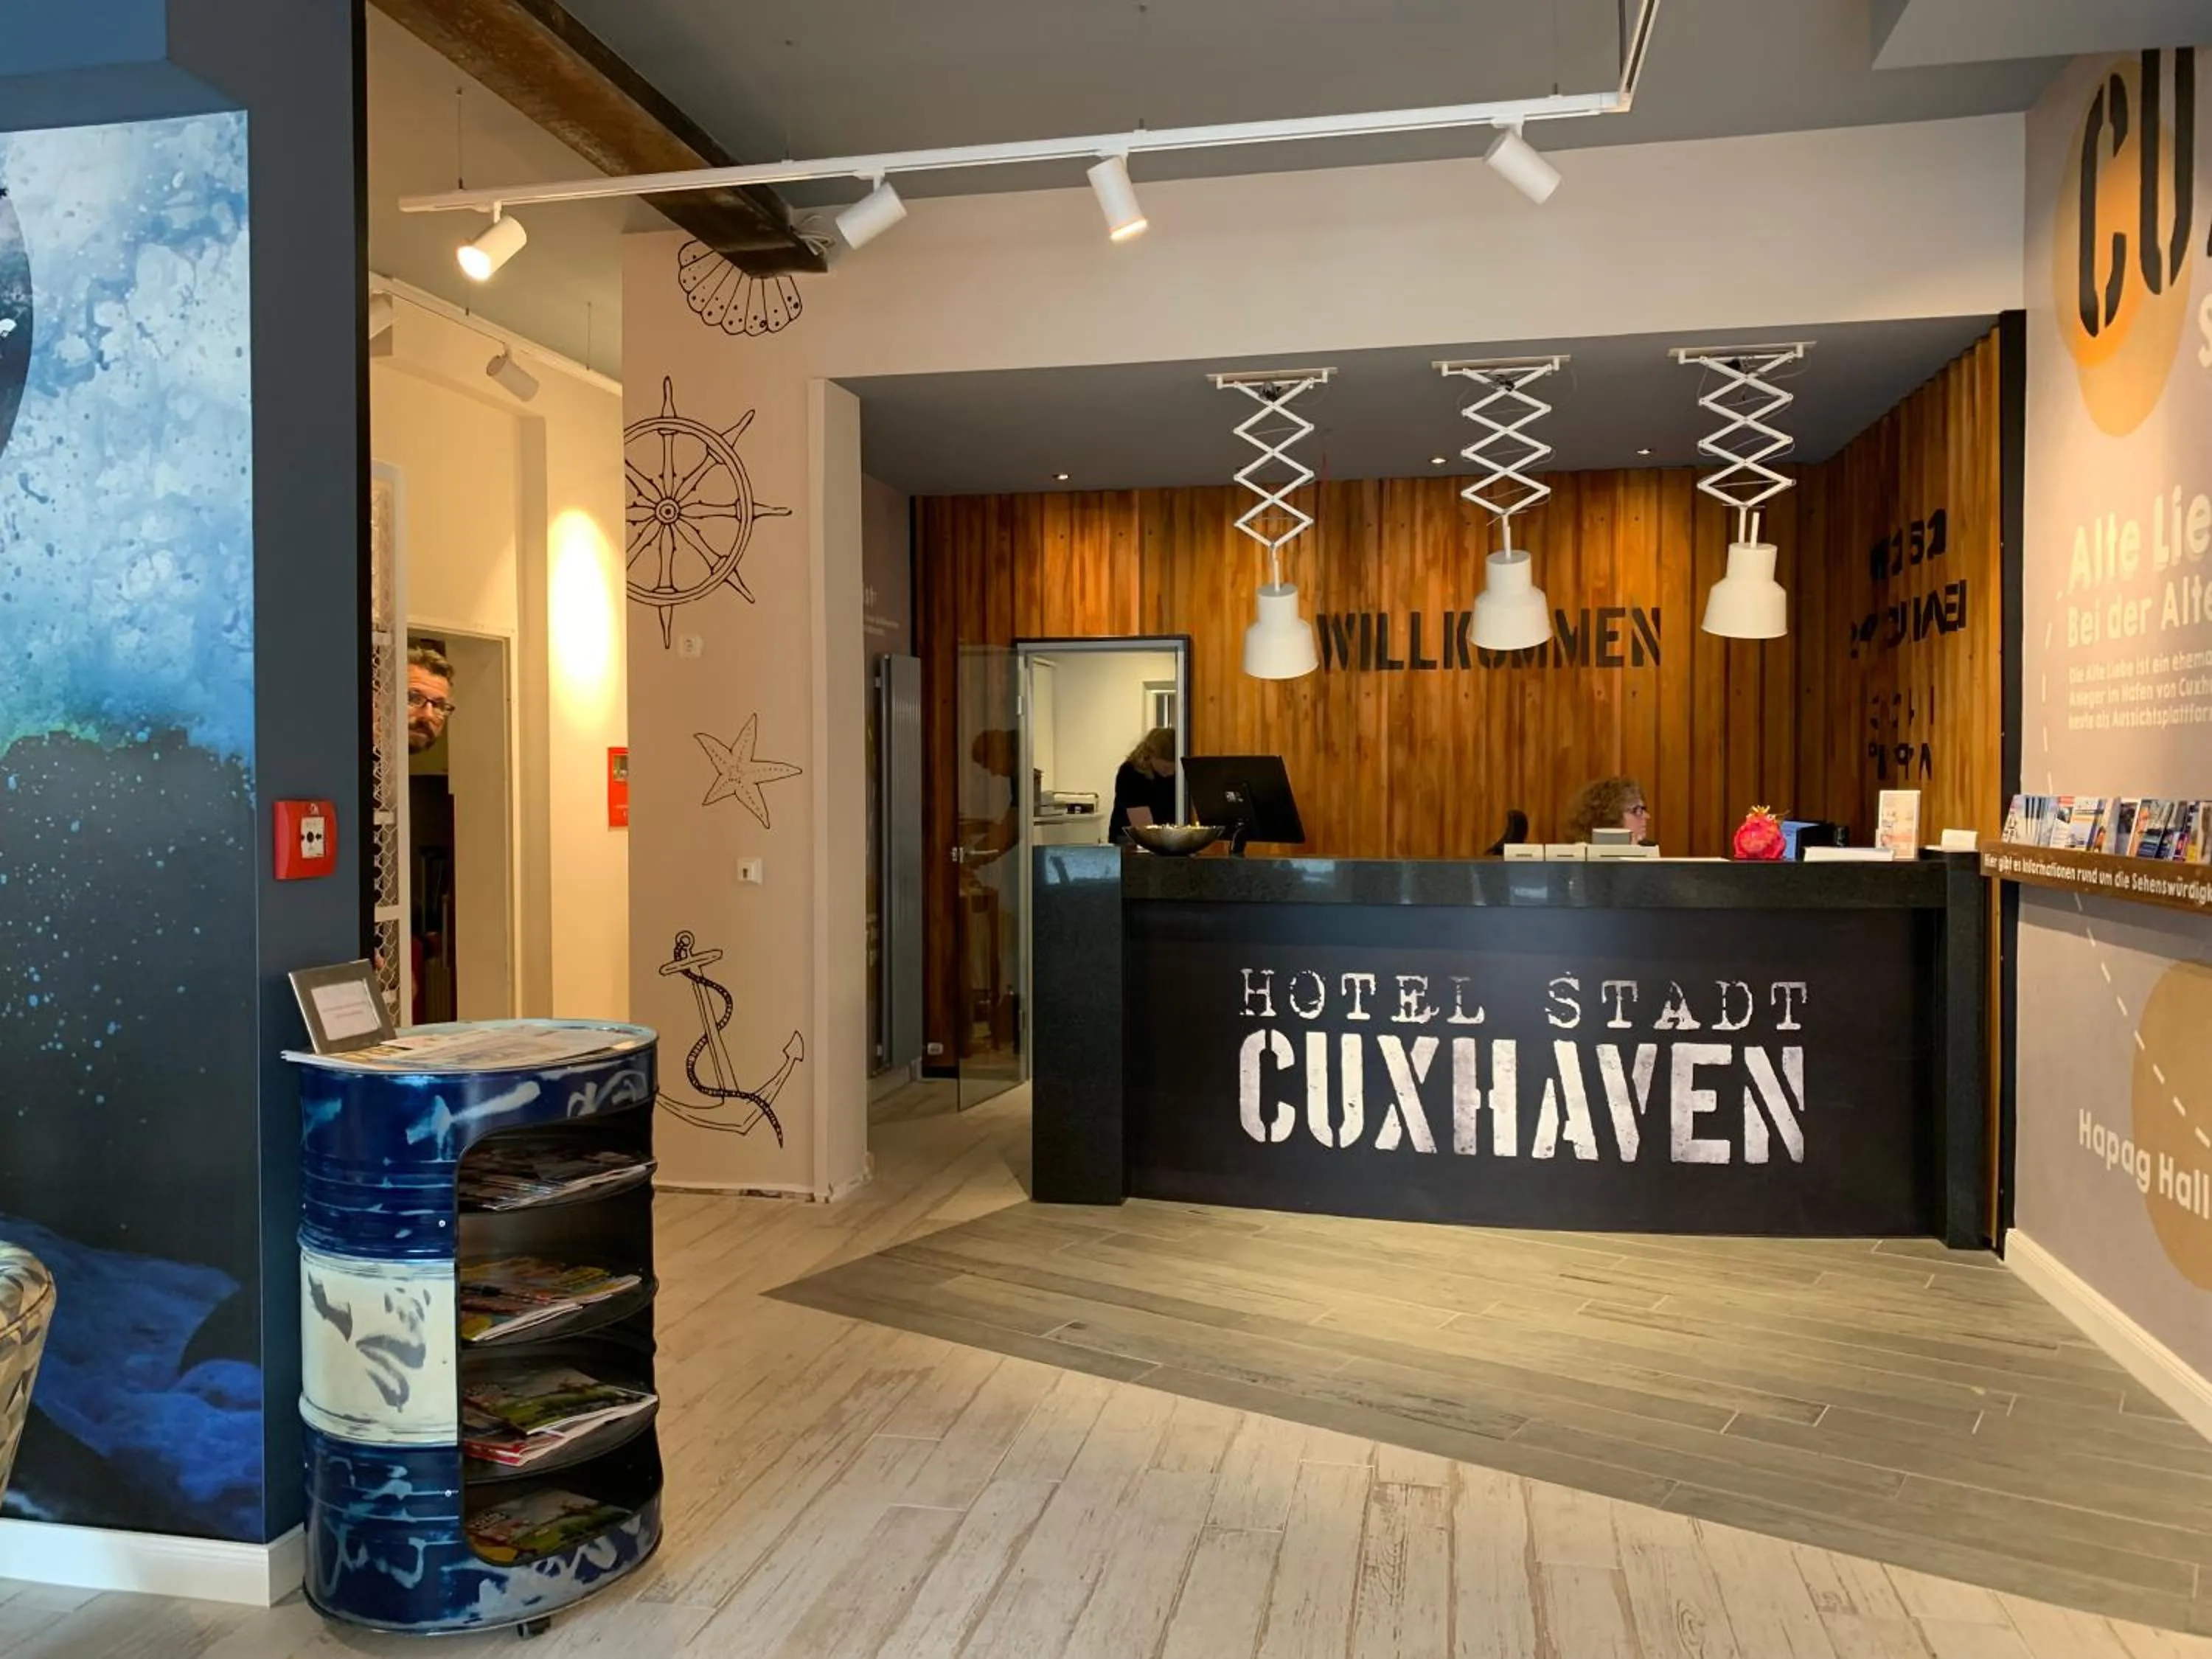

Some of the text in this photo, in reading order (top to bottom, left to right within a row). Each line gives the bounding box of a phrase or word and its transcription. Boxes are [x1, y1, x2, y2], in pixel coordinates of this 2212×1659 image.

[2079, 46, 2212, 338] CU
[2066, 484, 2211, 595] Alte Lie
[2067, 598, 2100, 648] Bei
[2107, 592, 2152, 640] der
[2153, 653, 2169, 674] ein
[2157, 683, 2176, 699] von
[2112, 703, 2212, 729] Aussichtsplattfor
[2077, 868, 2098, 884] rund
[2099, 871, 2112, 886] um
[2114, 870, 2130, 889] die
[1239, 968, 1808, 1030] HOTEL STADT
[1239, 1029, 1805, 1164] CUXHAVEN
[2079, 1108, 2210, 1220] Hapag Hall
